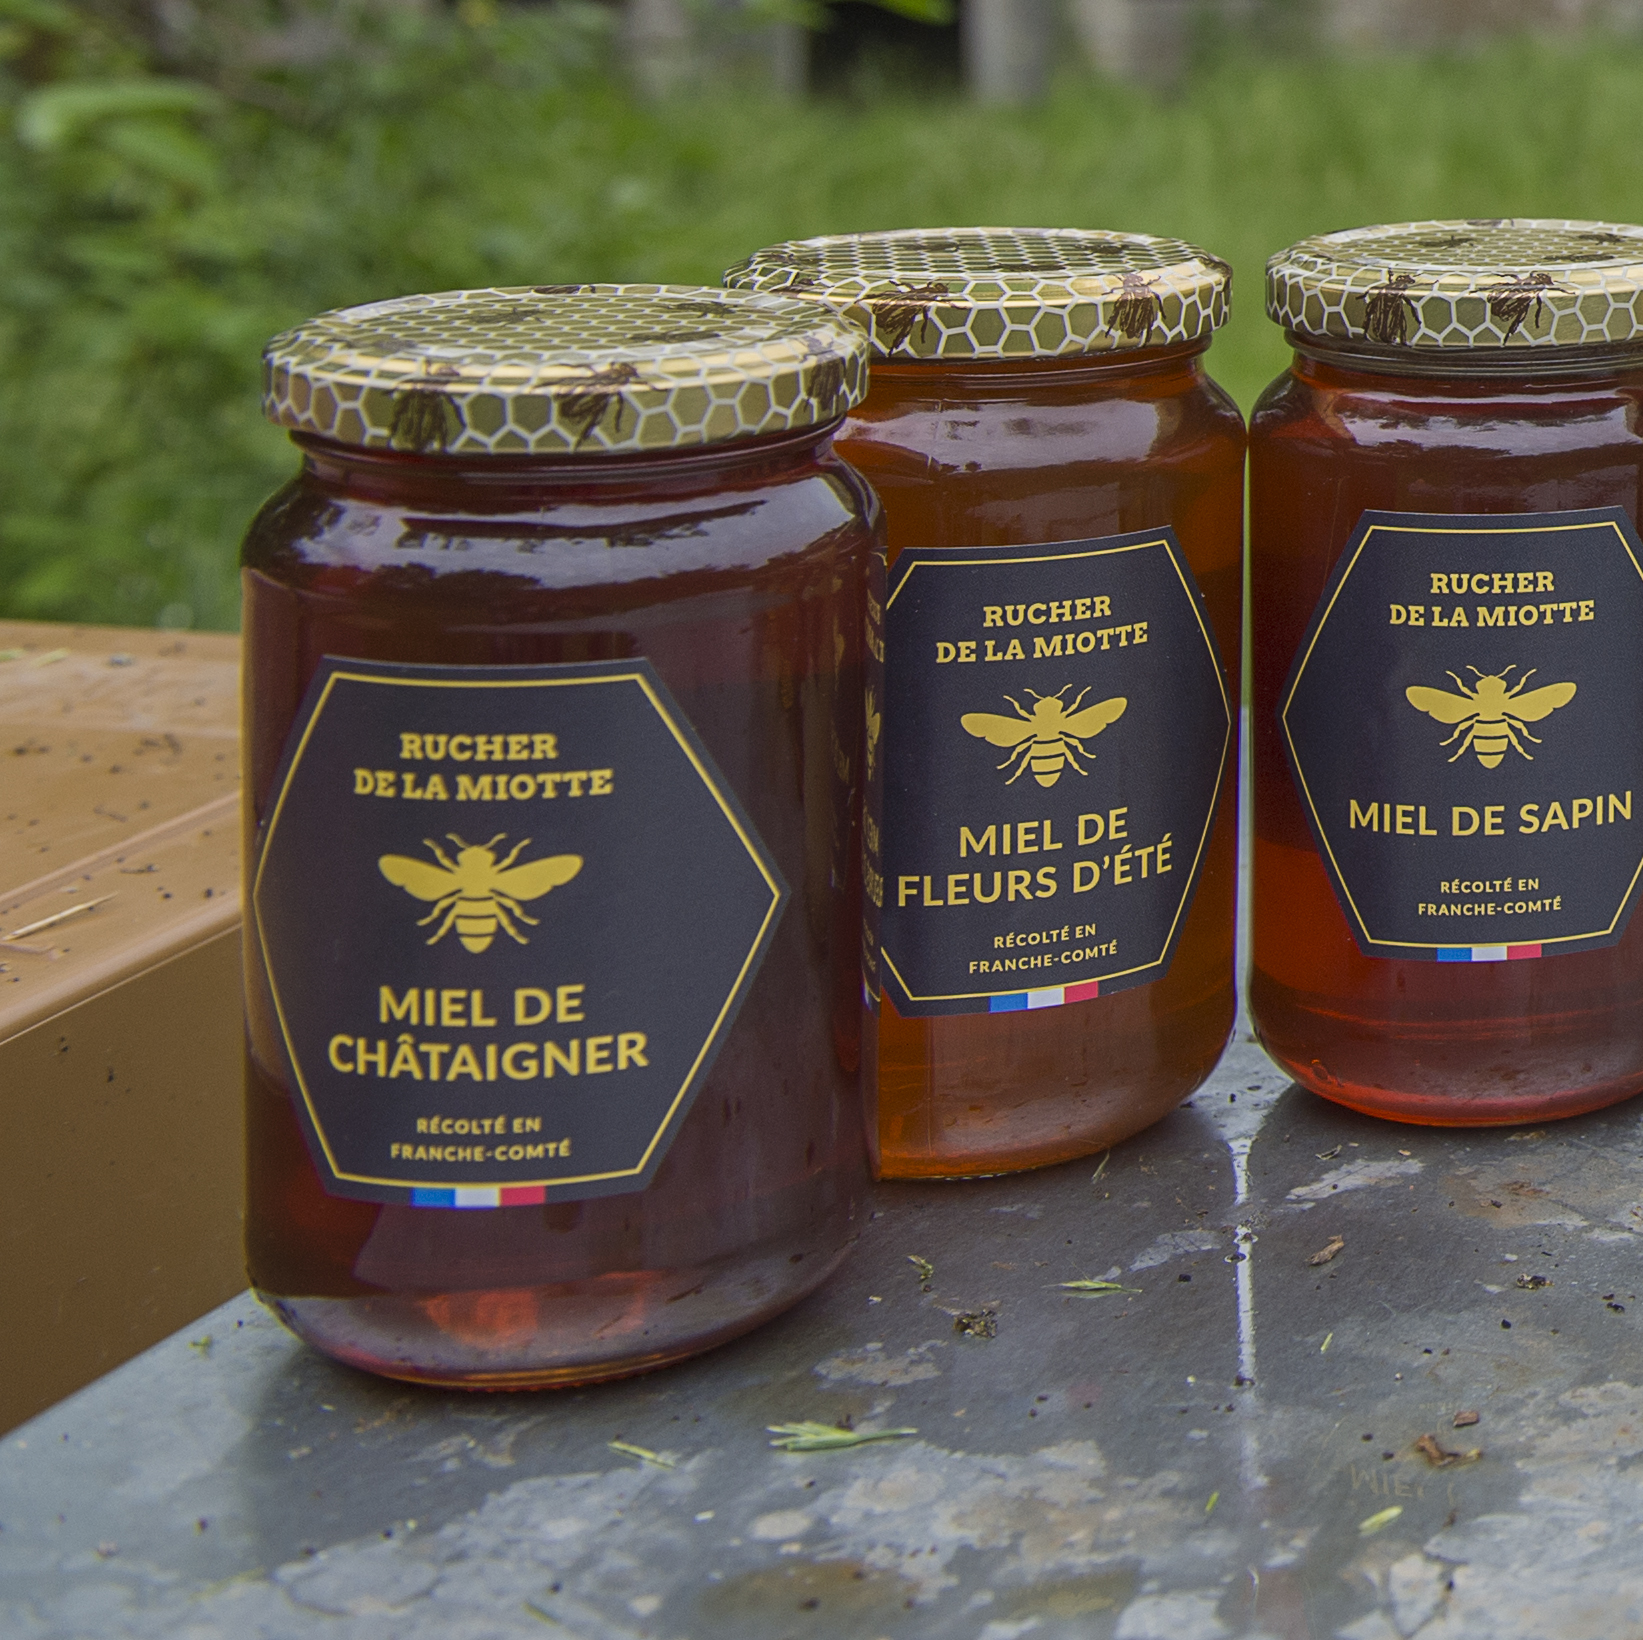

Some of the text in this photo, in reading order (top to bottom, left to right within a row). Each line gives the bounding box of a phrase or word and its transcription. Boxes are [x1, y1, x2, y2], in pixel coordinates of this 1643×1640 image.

[1430, 571, 1555, 594] RUCHER
[983, 595, 1112, 627] RUCHER
[1390, 599, 1595, 627] DE LA MIOTTE
[936, 621, 1148, 663] DE LA MIOTTE
[400, 732, 558, 761] RUCHER
[354, 767, 614, 801] DE LA MIOTTE
[1350, 790, 1632, 836] MIEL DE SAPIN
[960, 806, 1128, 858] MIEL DE
[898, 866, 1058, 907] FLEURS
[1440, 876, 1540, 894] RÉCOLTÉ EN
[1418, 895, 1562, 916] FRANCHE-COMTÉ
[994, 923, 1097, 949] RÉCOLTÉ EN
[969, 939, 1118, 974] FRANCHE-COMTÉ
[380, 984, 585, 1027] MIEL DE
[328, 1031, 649, 1081] CHÂTAIGNER
[416, 1115, 542, 1135] RÉCOLTÉ EN
[391, 1138, 571, 1162] FRANCHE-COMTÉ
